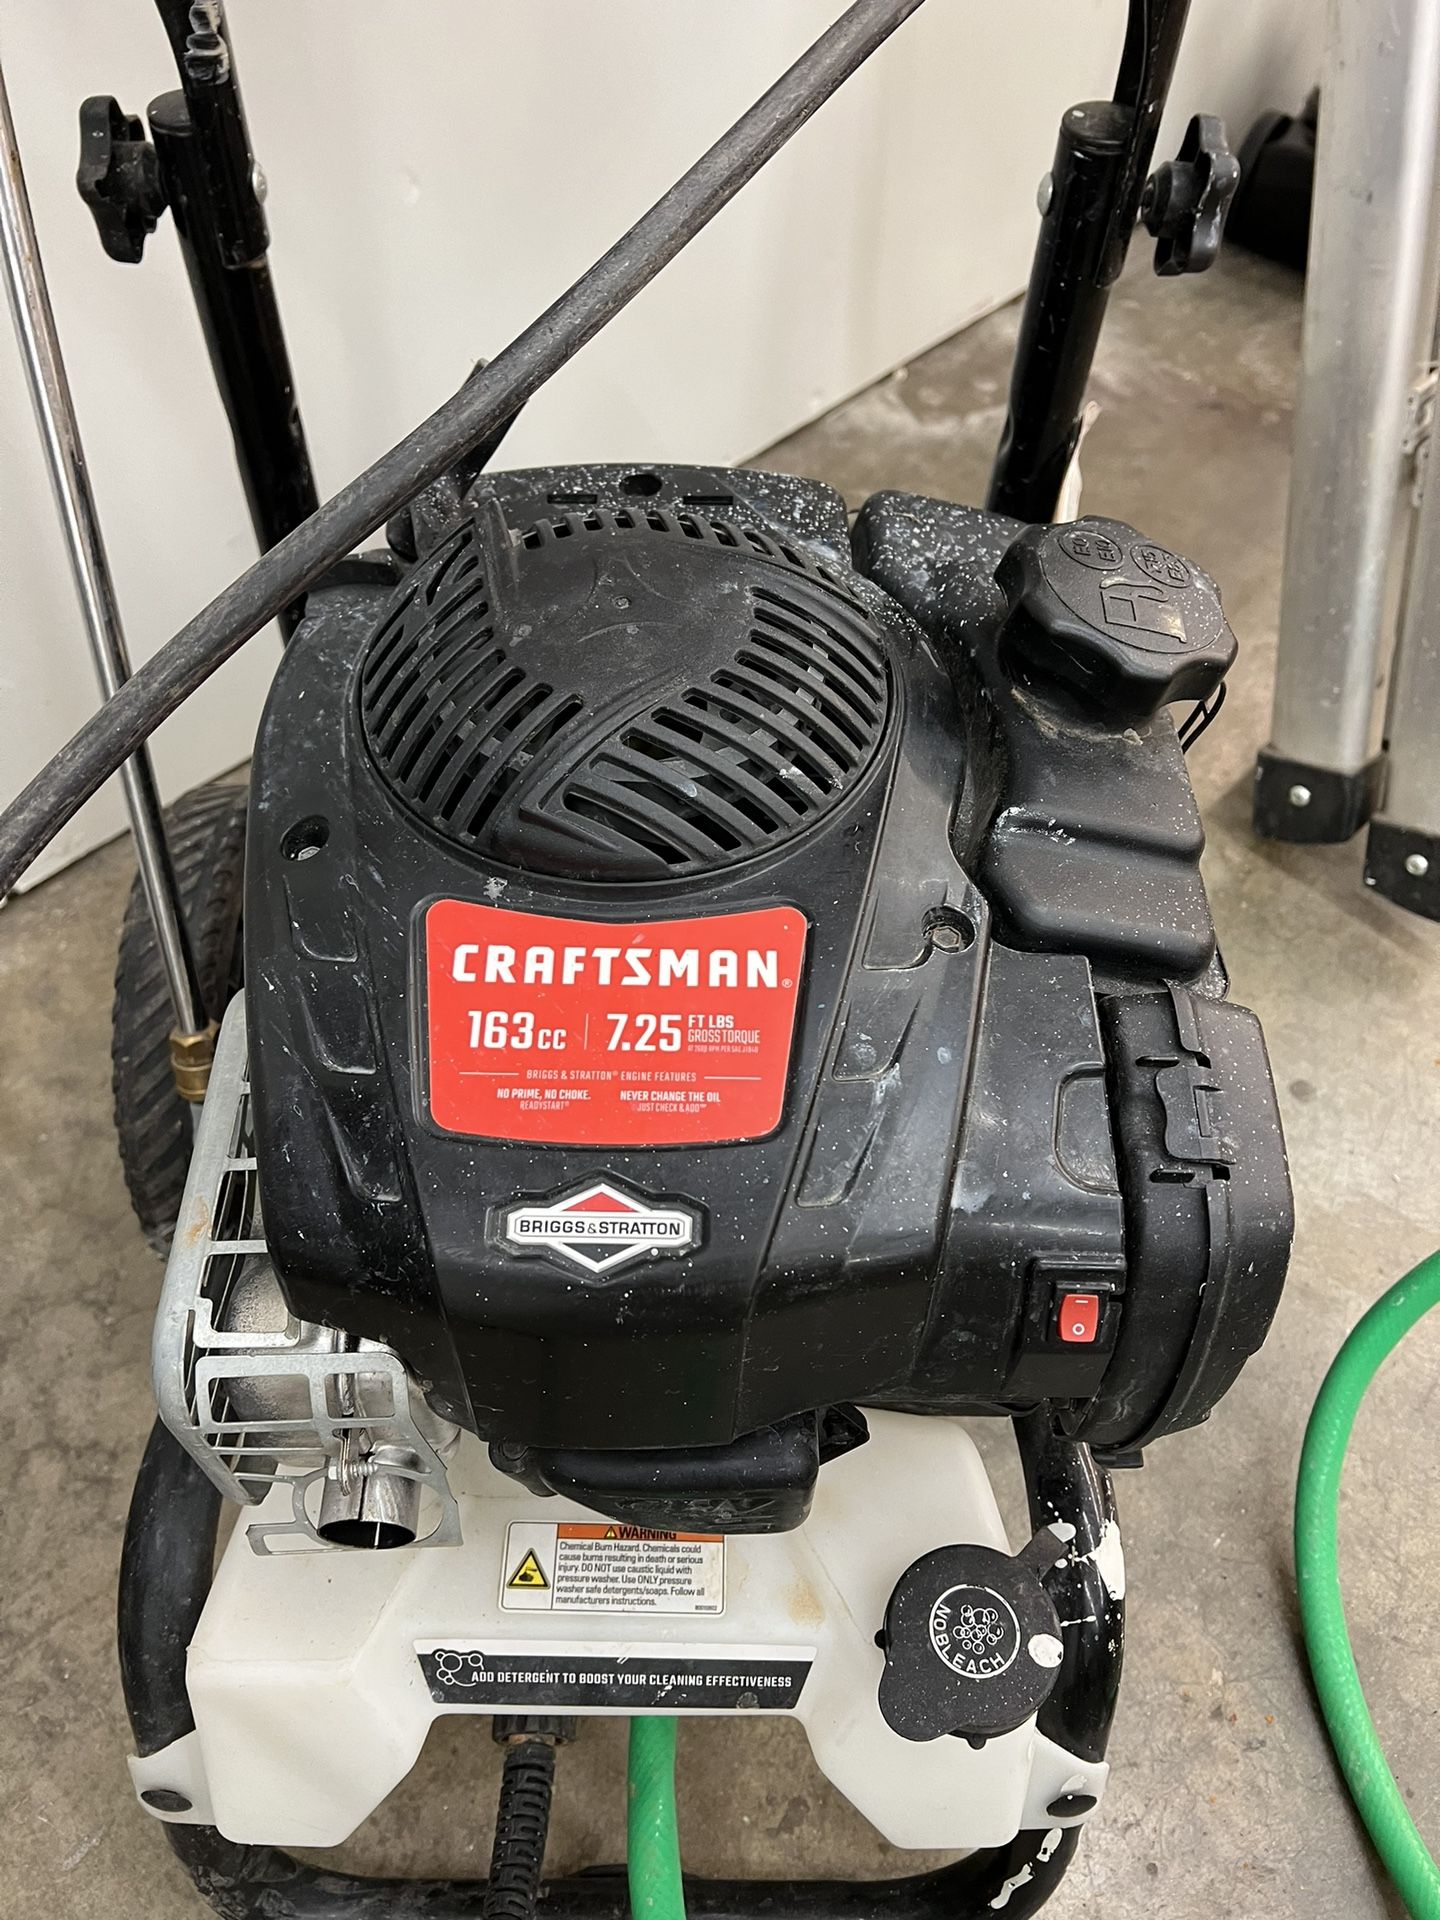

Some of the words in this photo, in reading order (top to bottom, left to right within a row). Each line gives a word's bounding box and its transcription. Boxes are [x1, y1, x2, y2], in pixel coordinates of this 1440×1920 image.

[688, 1014, 705, 1028] FT
[708, 1014, 734, 1029] LBS
[606, 1013, 682, 1052] 7.25
[688, 1029, 721, 1043] GROSS
[721, 1030, 760, 1045] TORQUE
[526, 1070, 559, 1080] BRIGGS
[561, 1070, 568, 1080] &
[621, 1071, 652, 1081] ENGINE
[654, 1072, 697, 1082] FEATURES
[496, 1088, 510, 1098] NO
[511, 1089, 543, 1100] PRIME,
[544, 1089, 557, 1099] NO
[558, 1089, 592, 1100] CHOKE.
[620, 1090, 649, 1101] NEVER
[650, 1091, 686, 1102] CHANGE
[688, 1092, 705, 1102] THE
[706, 1092, 721, 1103] OIL
[636, 1102, 654, 1112] JUST
[655, 1103, 678, 1112] CHECK
[618, 1526, 677, 1540] WARNING
[560, 1542, 594, 1550] Chemical
[594, 1542, 612, 1551] Burn
[614, 1543, 641, 1552] Hazard.
[642, 1544, 680, 1553] Chemicals
[681, 1545, 702, 1553] could
[582, 1553, 604, 1561] burns
[605, 1553, 637, 1564] resulting
[638, 1554, 644, 1562] in
[646, 1555, 666, 1563] death
[677, 1555, 704, 1564] serious
[558, 1562, 580, 1573] injury.
[582, 1563, 594, 1572] DO
[594, 1563, 612, 1572] NOT
[627, 1564, 654, 1573] caustic
[655, 1565, 675, 1575] liquid
[676, 1566, 692, 1574] with
[557, 1575, 590, 1583] pressure
[591, 1574, 620, 1582] washer.
[622, 1574, 636, 1584] Use
[638, 1575, 658, 1584] ONLY
[659, 1577, 692, 1586] pressure
[556, 1584, 584, 1593] washer
[586, 1585, 602, 1593] safe
[670, 1587, 696, 1596] Follow
[696, 1588, 705, 1596] all
[556, 1595, 610, 1604] manufacturers
[611, 1596, 656, 1606] instructions.
[933, 1603, 951, 1631] NO
[935, 1634, 1005, 1674] BLEACH
[471, 1671, 494, 1683] ADD
[498, 1671, 560, 1684] DETERGENT
[562, 1672, 576, 1684] TO
[580, 1672, 614, 1685] BOOST
[617, 1673, 647, 1686] YOUR
[649, 1674, 703, 1686] CLEANING
[706, 1675, 792, 1688] EFFECTIVENESS
